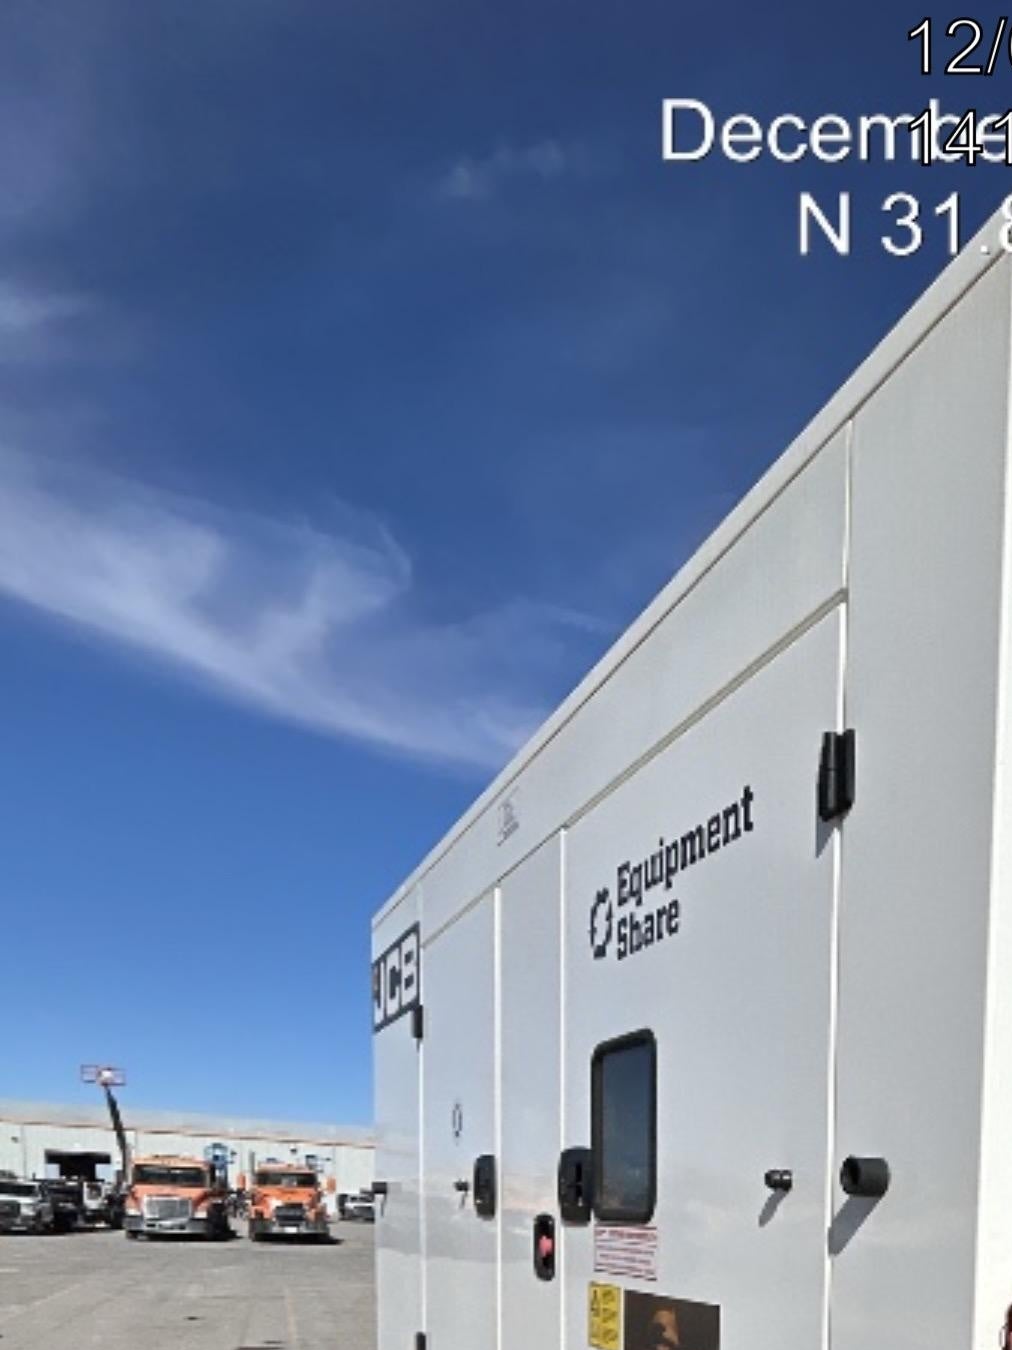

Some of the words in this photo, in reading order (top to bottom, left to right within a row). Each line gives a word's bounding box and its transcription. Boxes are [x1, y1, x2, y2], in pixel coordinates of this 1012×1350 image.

[617, 785, 754, 908] Equipment
[373, 926, 418, 1030] JCB
[617, 899, 680, 961] Share
